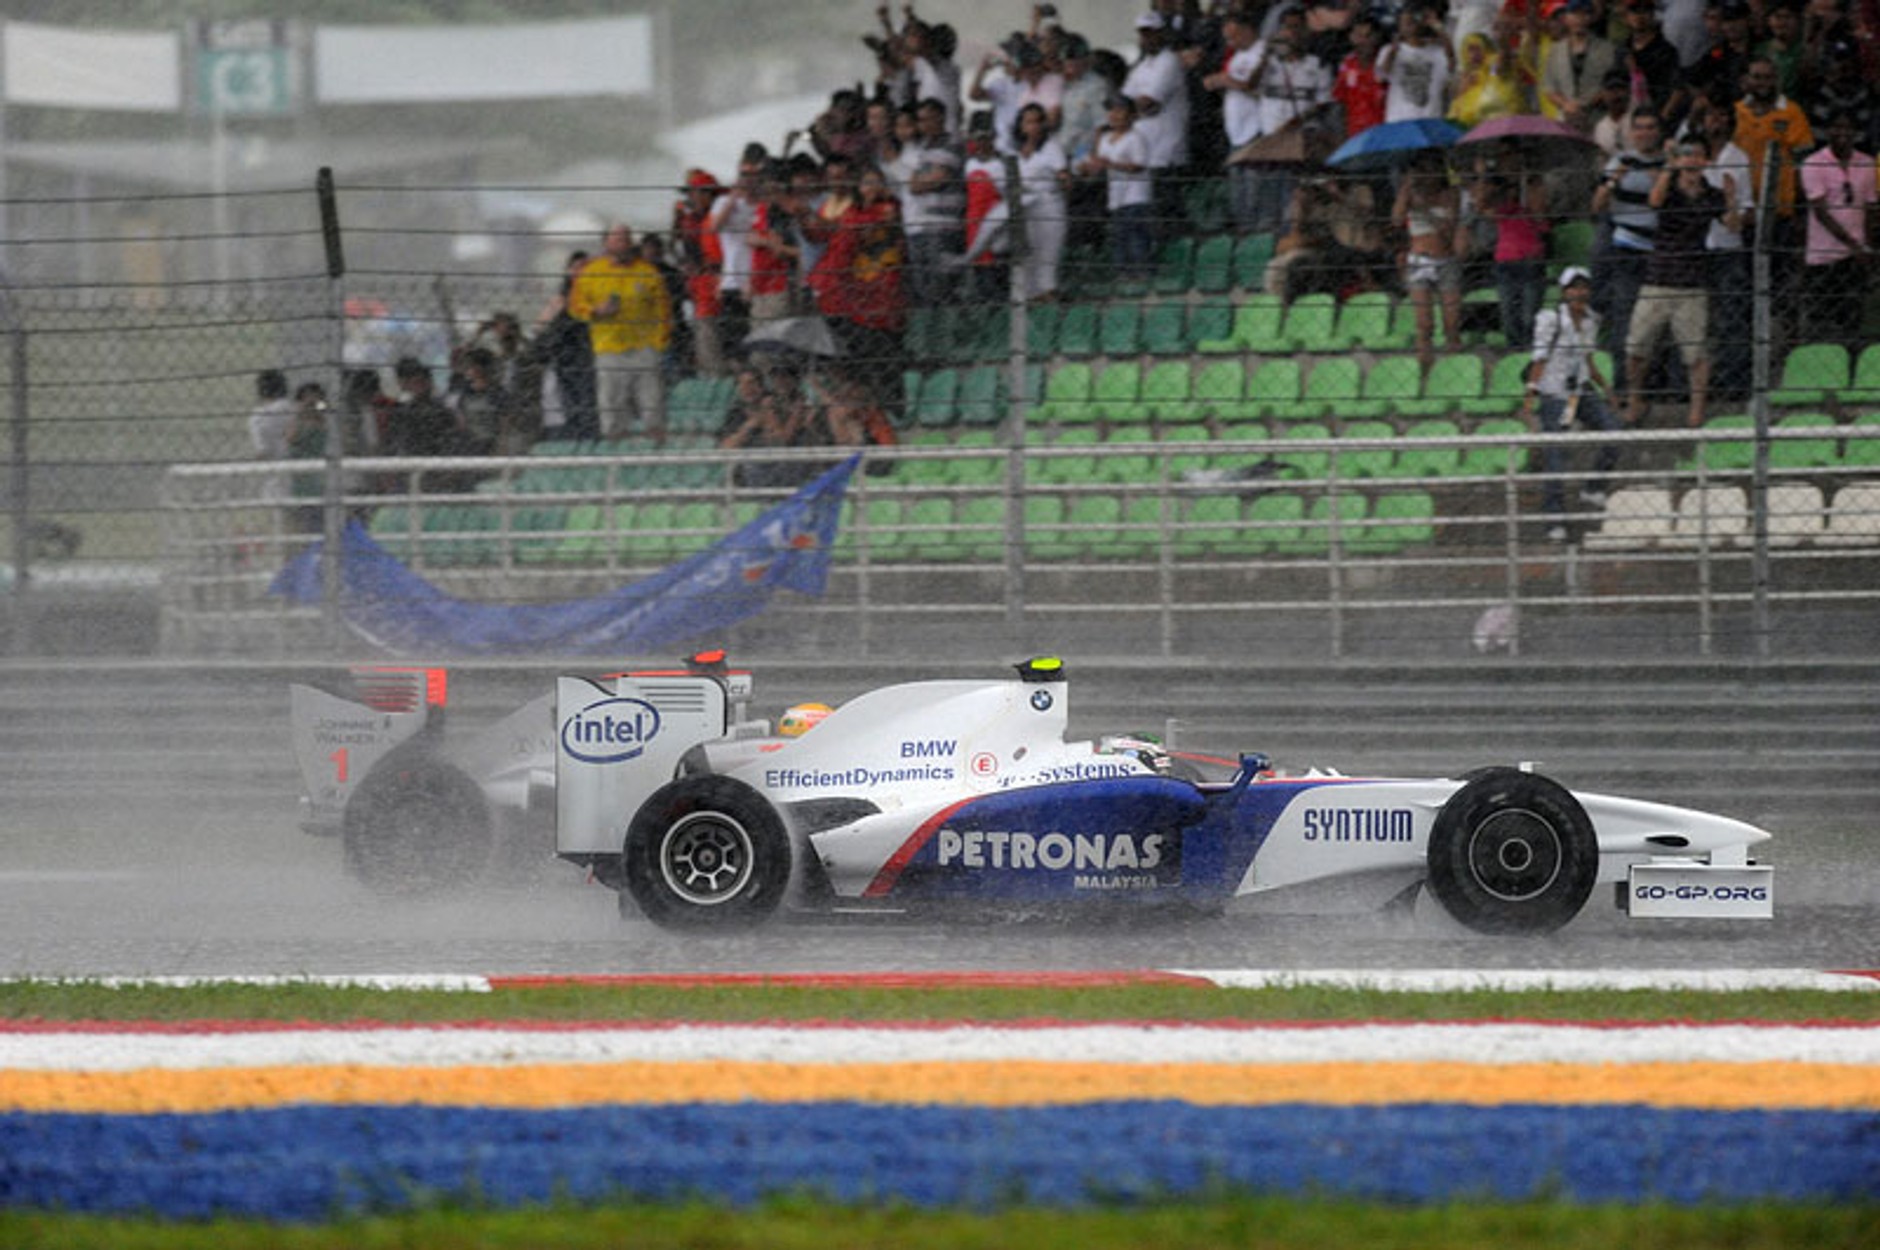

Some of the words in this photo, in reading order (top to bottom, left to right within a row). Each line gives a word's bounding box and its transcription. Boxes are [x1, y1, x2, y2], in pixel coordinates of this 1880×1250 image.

[211, 54, 275, 110] C3
[574, 713, 646, 744] intel
[328, 747, 347, 782] 1
[900, 740, 957, 759] BMW
[767, 765, 954, 789] EfficientDynamics
[1304, 808, 1412, 842] SYNTIUM
[938, 830, 1162, 869] PETRONAS
[1074, 875, 1157, 890] MALAYSIA
[1635, 886, 1768, 902] GO-GP.ORG
